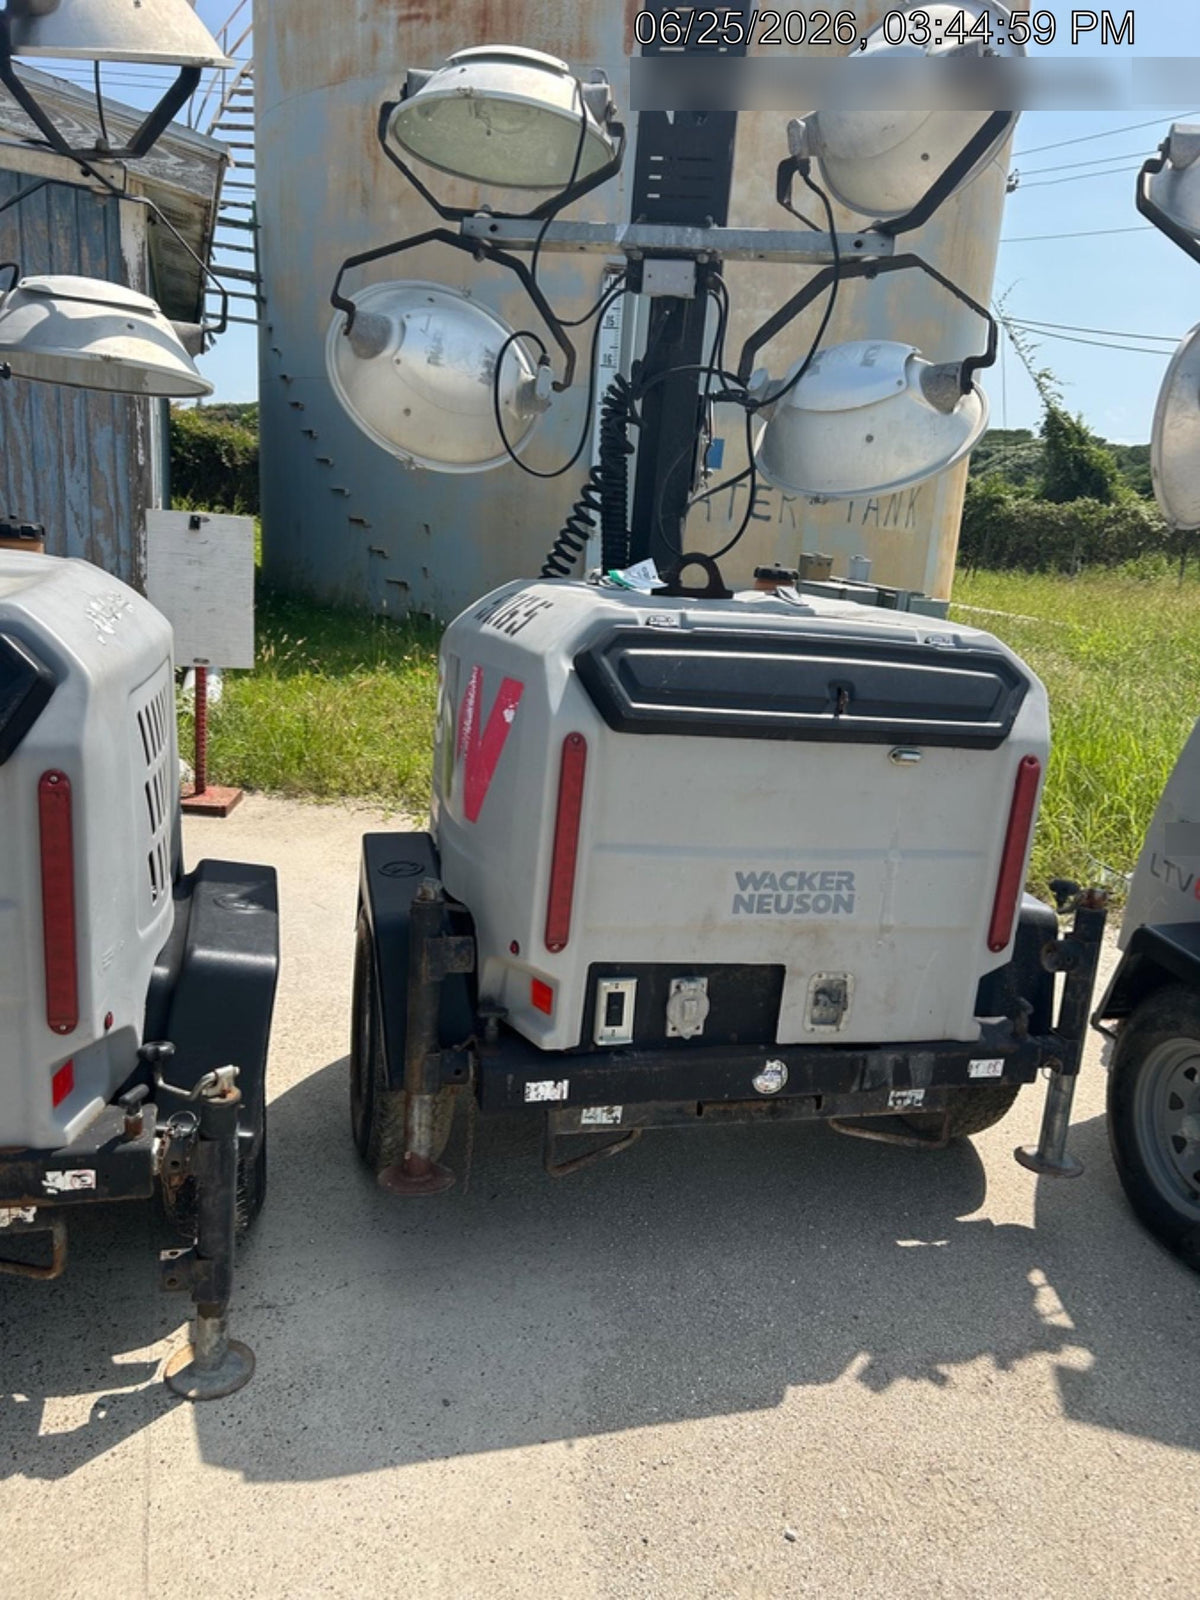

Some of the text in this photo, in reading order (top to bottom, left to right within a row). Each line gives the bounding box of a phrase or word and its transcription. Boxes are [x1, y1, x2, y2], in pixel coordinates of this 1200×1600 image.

[690, 483, 798, 529] ATER
[735, 870, 856, 892] WACKER
[1150, 852, 1200, 902] LTV
[732, 893, 856, 915] NEUSON
